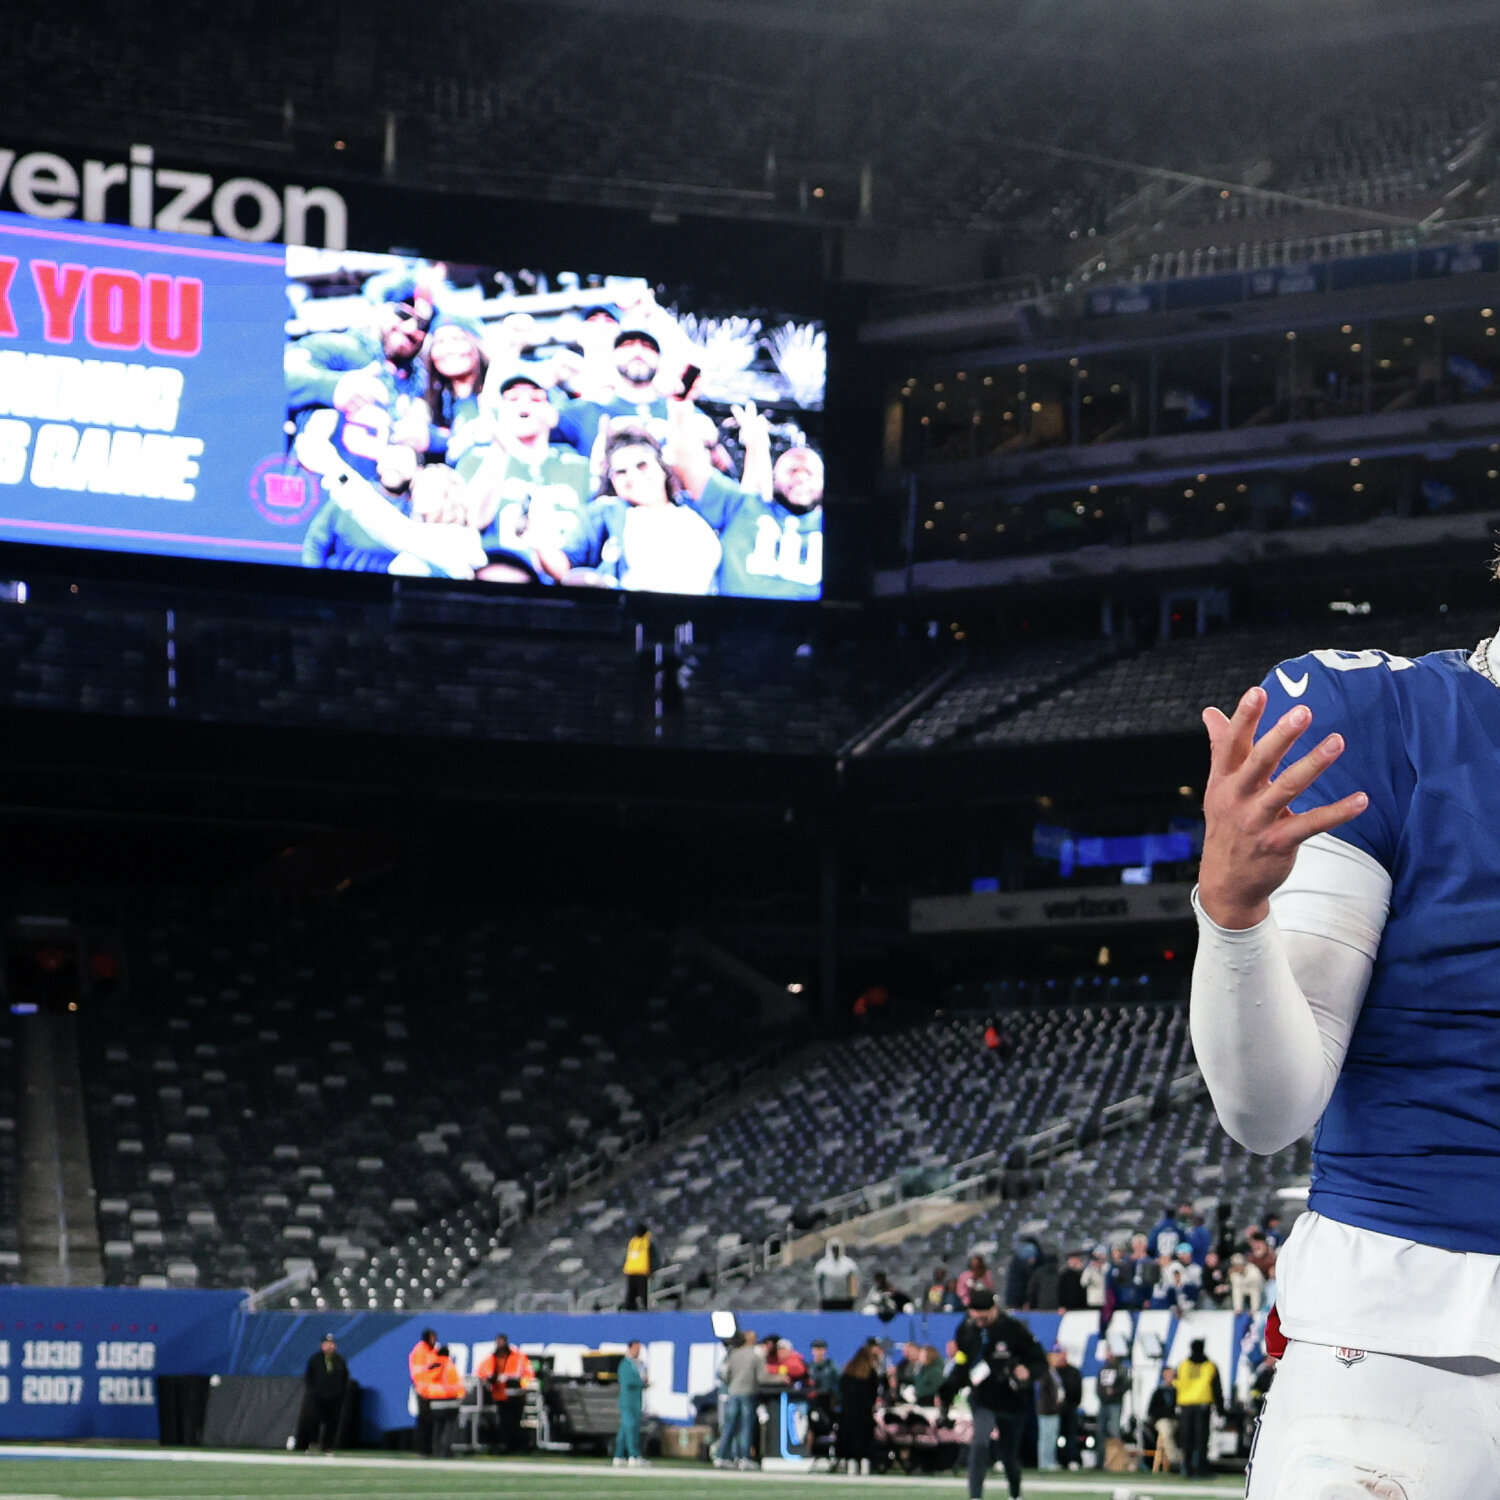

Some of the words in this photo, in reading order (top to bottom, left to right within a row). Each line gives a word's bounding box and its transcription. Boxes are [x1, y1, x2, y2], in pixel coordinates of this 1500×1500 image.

[0, 144, 347, 251] erizon
[30, 259, 203, 357] YOU
[22, 1375, 83, 1404] 2007
[98, 1376, 155, 1405] 2011
